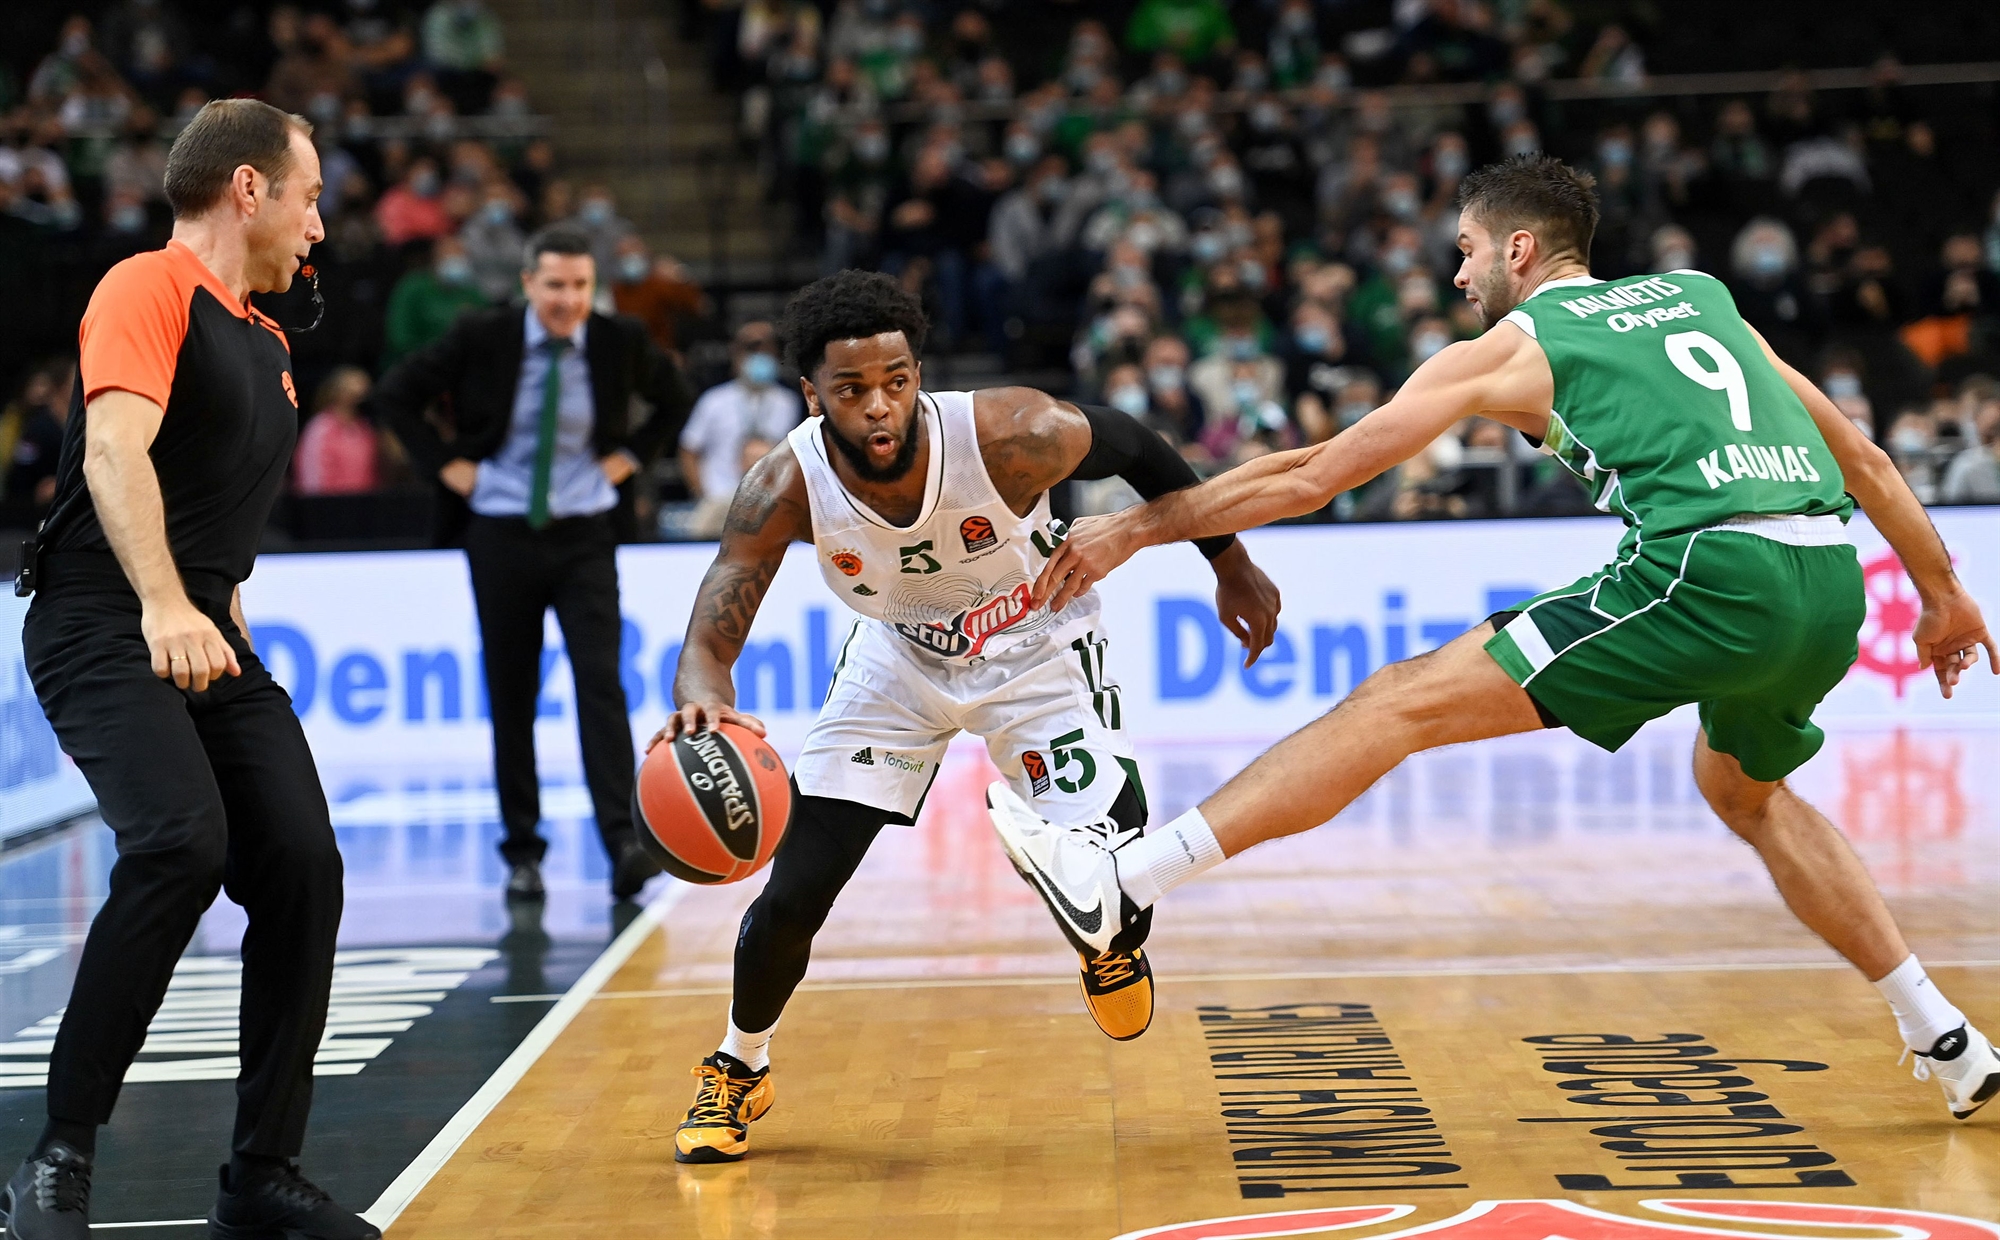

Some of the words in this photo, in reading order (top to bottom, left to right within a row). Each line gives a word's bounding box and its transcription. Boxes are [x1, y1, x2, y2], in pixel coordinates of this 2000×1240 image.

[1559, 277, 1684, 318] KALNIETIS
[1606, 301, 1701, 333] OlyBet
[1665, 330, 1752, 431] 9
[1696, 443, 1821, 490] KAUNAS
[898, 540, 942, 575] 5
[684, 729, 755, 831] SPALDING
[851, 755, 875, 766] adidas
[883, 751, 925, 774] Tonovit
[1050, 727, 1098, 794] 5
[1195, 1002, 1412, 1080] AIRLINES
[1517, 1032, 1857, 1191] EuroLeague
[1218, 1086, 1470, 1199] TURKISH
